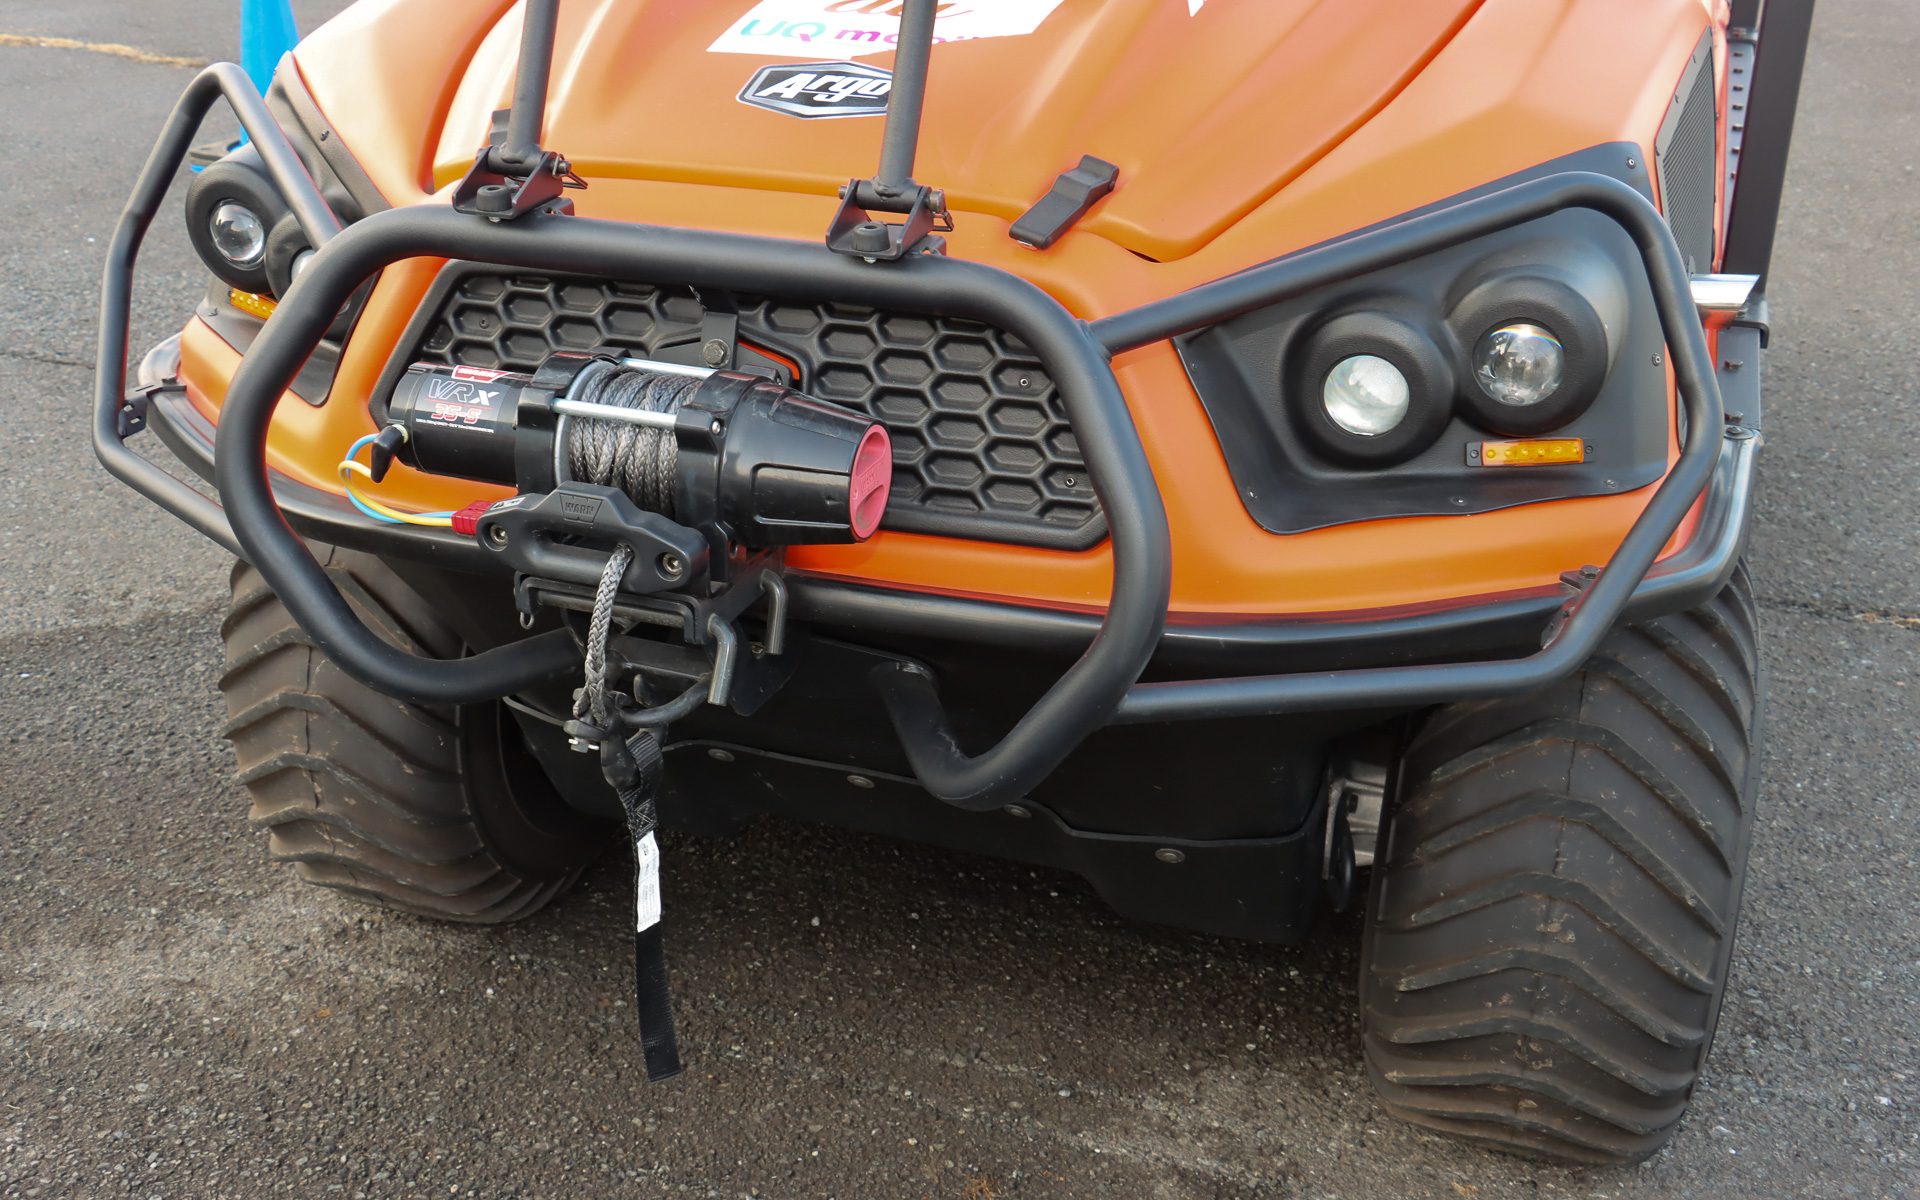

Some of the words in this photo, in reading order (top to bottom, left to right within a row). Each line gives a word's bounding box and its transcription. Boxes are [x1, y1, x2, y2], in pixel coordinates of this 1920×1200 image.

[740, 19, 827, 42] UQ
[428, 378, 500, 406] VRX
[430, 403, 482, 425] 35-S
[564, 501, 594, 516] WARN
